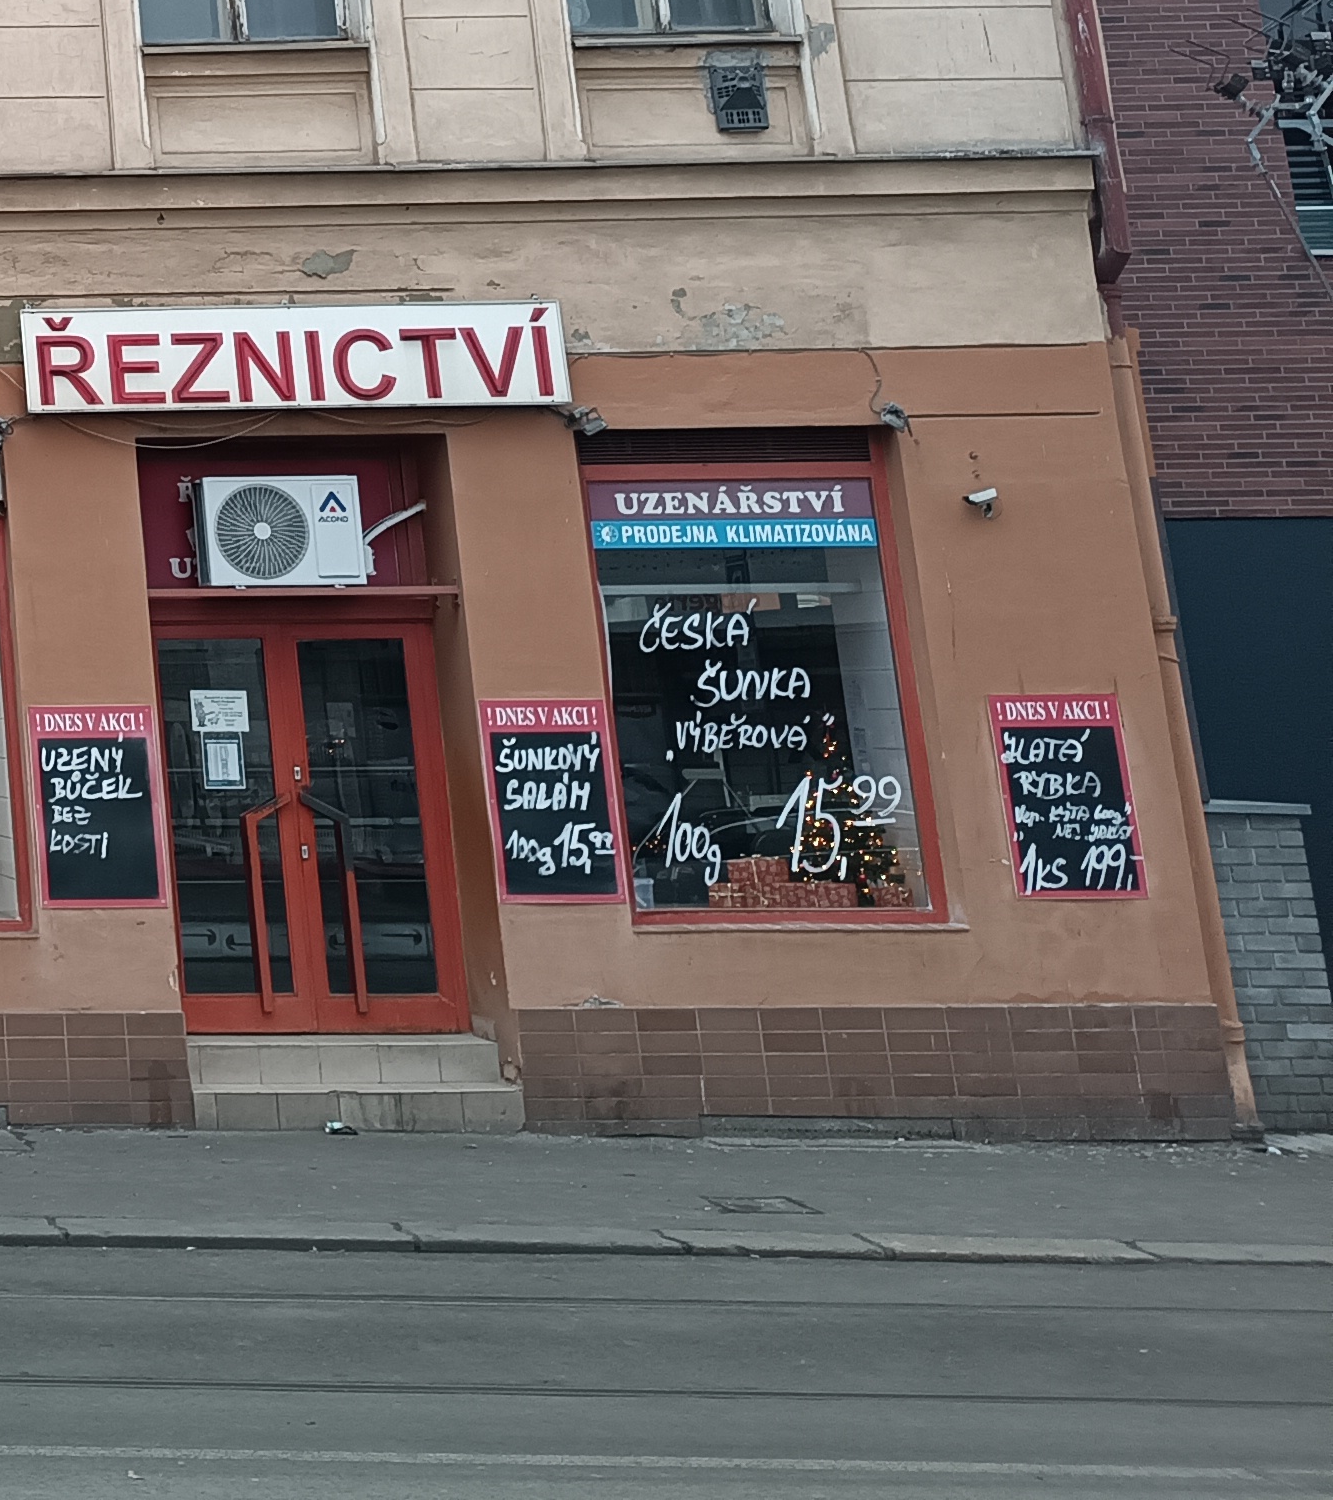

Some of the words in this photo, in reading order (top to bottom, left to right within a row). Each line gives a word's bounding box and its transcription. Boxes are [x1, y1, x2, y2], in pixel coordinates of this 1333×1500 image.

[34, 307, 554, 406] ŘEZNICTVÍ
[614, 484, 845, 515] UZENÁŘSTVÍ
[317, 515, 349, 523] ACOND
[621, 524, 719, 544] PRODEJNA
[726, 518, 874, 543] KLIMATIZOVÁNA
[638, 598, 758, 653] ČESKÁ
[689, 658, 811, 708] ŠUNKA
[44, 714, 83, 732] DNES
[85, 713, 95, 732] V
[98, 712, 136, 732] AKCI
[495, 707, 535, 726] DNES
[537, 707, 549, 726] V
[551, 706, 589, 726] AKCI
[1005, 702, 1046, 720] DNES
[1047, 702, 1059, 720] V
[1063, 700, 1103, 720] AKCI
[41, 732, 124, 774] UZENÝ
[495, 731, 601, 773] ŠUNKOVÝ
[47, 770, 143, 804] BŮČEK
[503, 772, 591, 811] SALÁM
[1013, 771, 1102, 800] RYBKA
[51, 805, 91, 825] BEZ
[49, 828, 109, 860] KOSTI
[655, 792, 722, 887] 100g
